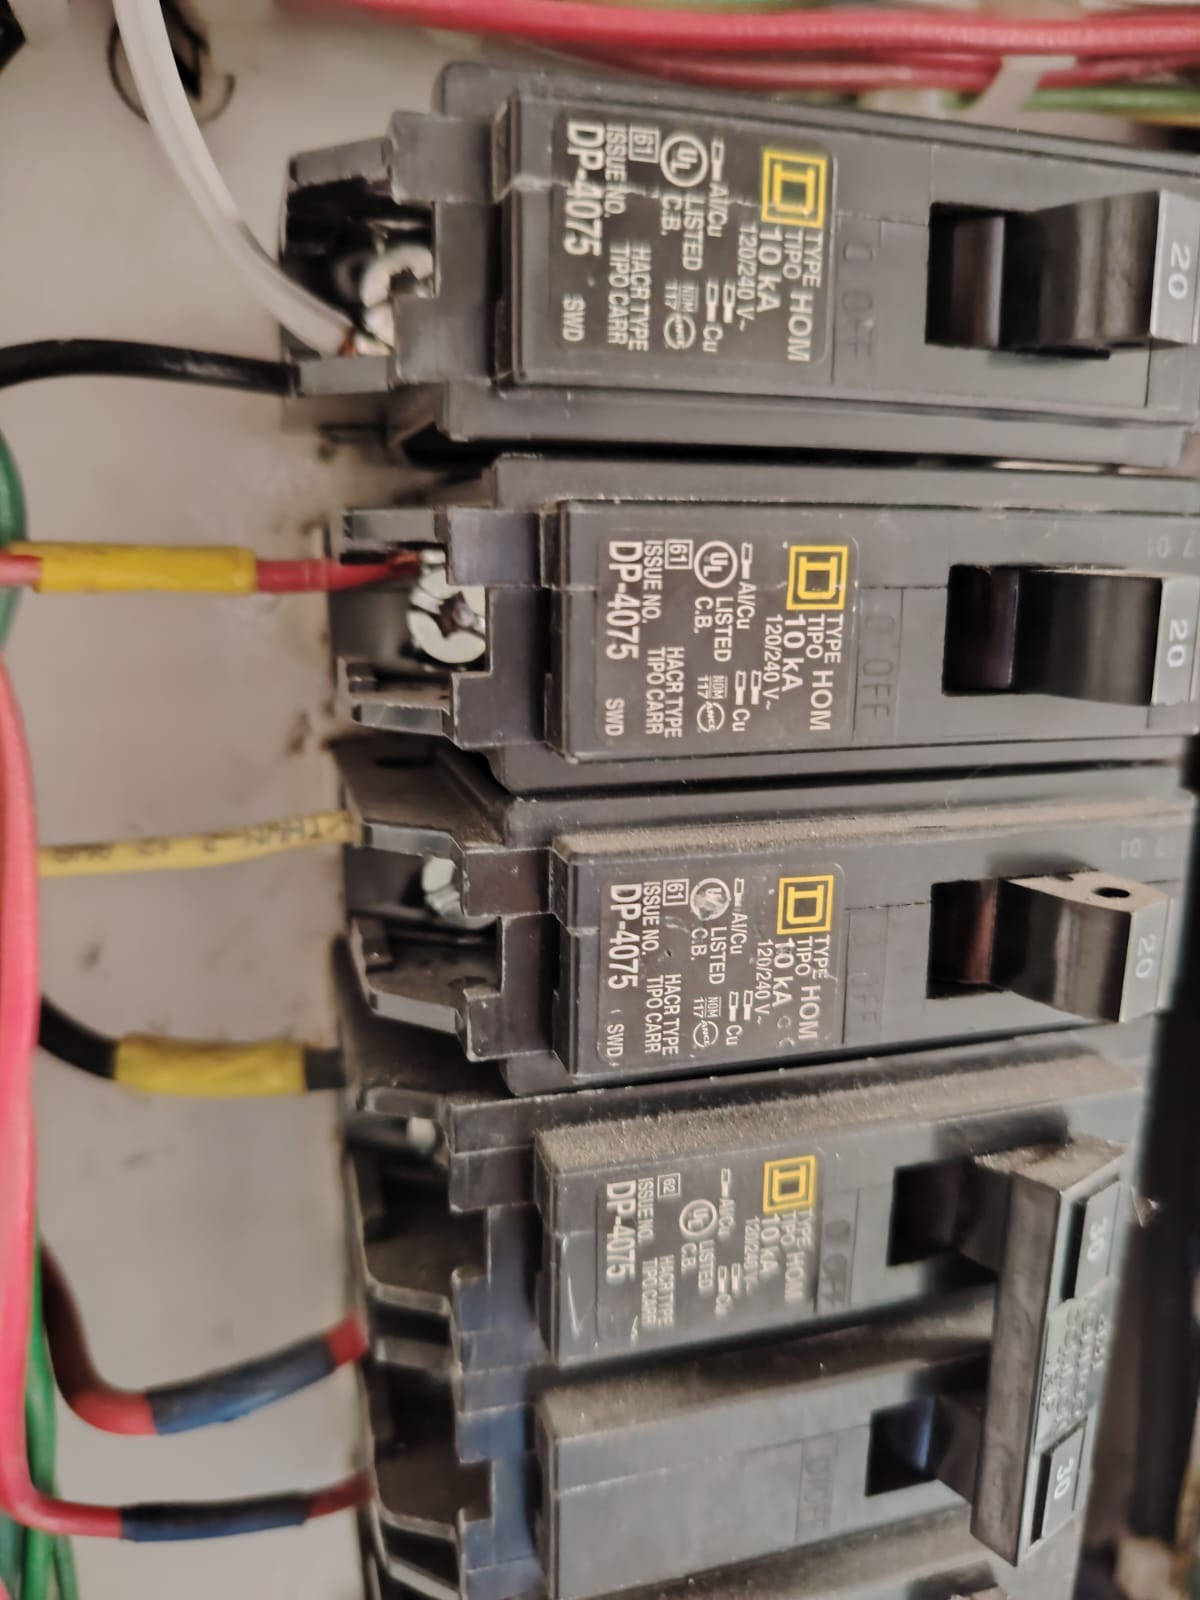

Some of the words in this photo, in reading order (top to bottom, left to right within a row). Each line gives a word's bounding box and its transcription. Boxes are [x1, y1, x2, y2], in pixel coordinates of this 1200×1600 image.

[605, 125, 626, 181] ISSUE
[565, 121, 603, 256] DP-4075
[605, 187, 625, 218] NO.
[661, 197, 683, 236] C.B.
[682, 197, 703, 270] LISTED
[608, 245, 629, 287] TIPO
[737, 224, 757, 299] 120/240
[759, 227, 781, 265] 10
[783, 230, 802, 279] TIPO
[802, 232, 823, 288] TYPE
[630, 245, 651, 300] HACR
[1168, 242, 1192, 300] 20
[757, 275, 780, 312] kA
[563, 296, 584, 341] SWD
[608, 292, 628, 344] CARR
[628, 306, 649, 352] TYPE
[702, 325, 722, 353] Cu
[787, 292, 812, 362] HOM
[643, 541, 662, 590] ISSUE
[606, 542, 642, 659] DP-4075
[643, 594, 661, 623] NO.
[694, 597, 712, 633] C.B.
[714, 597, 730, 662] LISTED
[763, 614, 782, 682] 120/240
[783, 615, 803, 648] 10
[807, 615, 824, 659] TIPO
[824, 614, 843, 663] TYPE
[1165, 619, 1188, 668] 20
[647, 648, 664, 685] TIPO
[665, 647, 683, 692] HACR
[697, 675, 708, 698] 117
[782, 659, 803, 692] kA
[810, 670, 833, 731] HOM
[862, 658, 893, 720] OFF
[605, 698, 623, 735] SWD
[646, 689, 664, 734] CARR
[664, 699, 682, 738] TYPE
[732, 708, 749, 731] Cu
[643, 882, 661, 925] ISSUE
[609, 884, 641, 989] DP-4075
[641, 930, 659, 955] NO.
[691, 927, 708, 960] C.B.
[709, 927, 726, 984] LISTED
[775, 937, 794, 968] 10
[795, 936, 813, 976] TIPO
[812, 935, 830, 979] TYPE
[1134, 934, 1155, 979] 20
[755, 940, 773, 999] 120/240
[647, 975, 663, 1009] TIPO
[664, 974, 681, 1015] HACR
[693, 997, 703, 1017] 117
[773, 977, 793, 1007] kA
[798, 986, 821, 1039] HOM
[607, 1024, 625, 1056] SWD
[645, 1013, 662, 1053] CARR
[663, 1019, 679, 1055] TYPE
[726, 1025, 742, 1045] Cu
[637, 1178, 653, 1218] ISSUE
[606, 1180, 635, 1279] DP-4075
[744, 1217, 759, 1272] 120/240
[762, 1214, 780, 1240] 10
[781, 1212, 797, 1246] TIPO
[796, 1210, 812, 1248] TYPE
[1085, 1216, 1109, 1261] 30
[643, 1259, 659, 1286] TIPO
[659, 1255, 674, 1292] HACR
[698, 1240, 714, 1289] LISTED
[760, 1247, 779, 1273] kA
[785, 1252, 803, 1299] HOM
[642, 1290, 657, 1325] CARR
[658, 1293, 673, 1327] TYPE
[716, 1294, 730, 1313] Cu
[1053, 1455, 1074, 1501] 30
